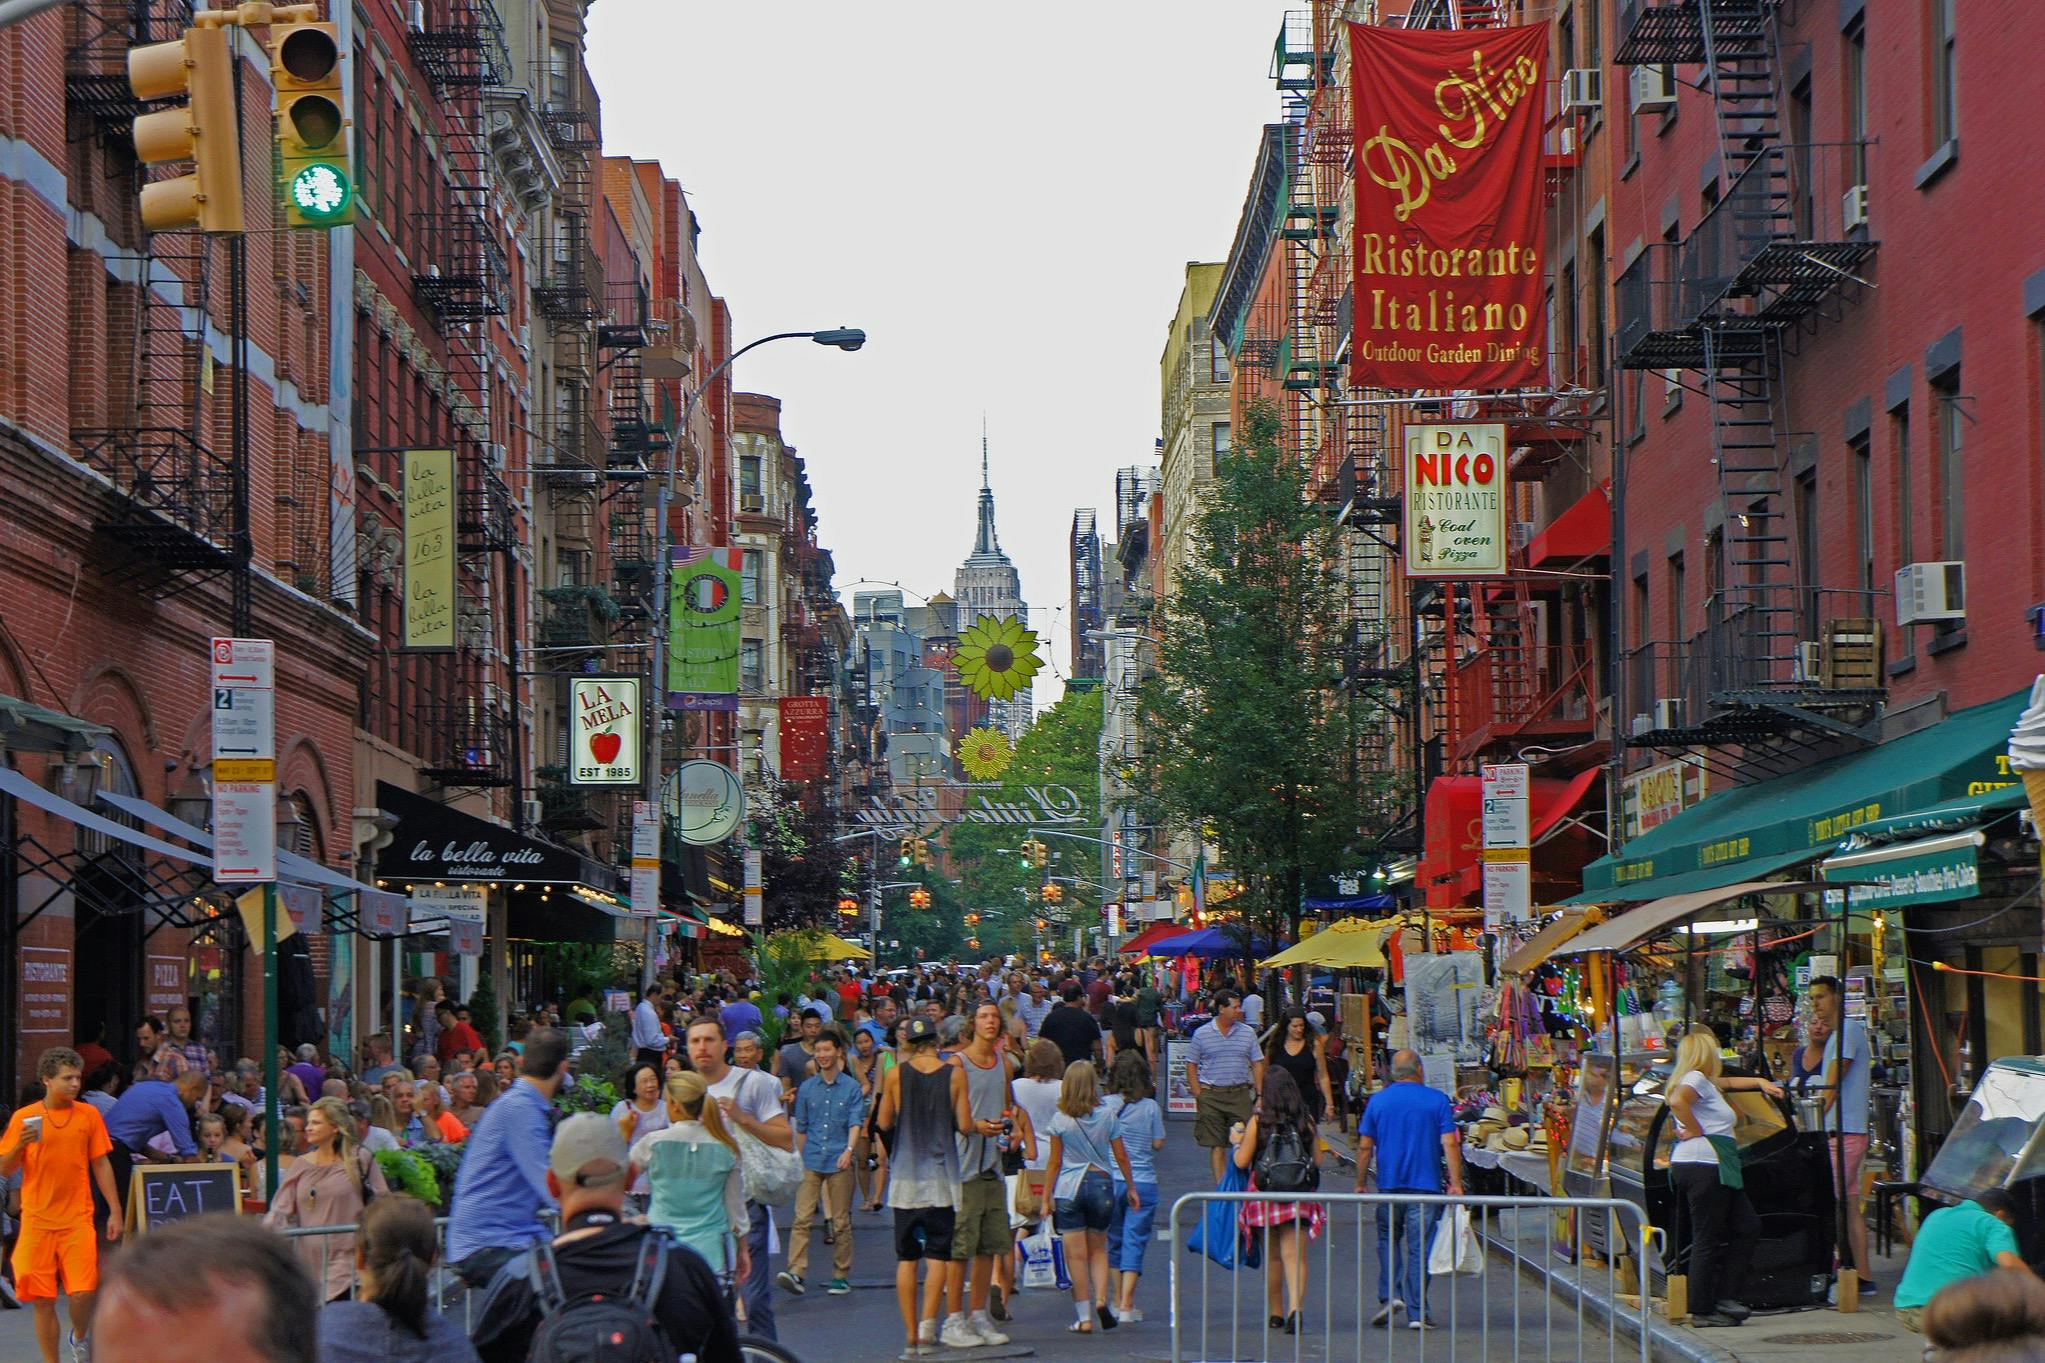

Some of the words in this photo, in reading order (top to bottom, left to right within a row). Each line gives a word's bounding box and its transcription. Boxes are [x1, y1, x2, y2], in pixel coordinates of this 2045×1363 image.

[1362, 125, 1456, 222] Da
[1435, 50, 1538, 149] Nico
[1362, 233, 1537, 277] Ristorante
[1371, 289, 1527, 332] Italiano
[1362, 340, 1423, 363] Outdoor
[1426, 342, 1482, 364] Garden
[1437, 431, 1473, 447] DA
[411, 461, 437, 481] la
[1415, 453, 1494, 486] NICO
[407, 479, 448, 504] bella
[1413, 492, 1497, 510] RISTORANTE
[410, 500, 447, 519] vita
[1438, 518, 1476, 532] Coal
[413, 534, 443, 560] 163
[1453, 535, 1491, 546] oven
[1438, 548, 1479, 562] Pizza
[413, 580, 437, 601] la
[409, 599, 449, 624] bella
[410, 619, 448, 639] vita
[217, 690, 229, 708] 2
[578, 685, 613, 711] LA
[580, 701, 632, 731] MELA
[580, 768, 601, 777] EST
[606, 767, 631, 777] 1985
[1484, 768, 1495, 780] NO
[230, 785, 261, 793] PARKING
[1486, 801, 1493, 813] 2
[410, 840, 435, 862] la
[441, 841, 497, 863] bella
[502, 848, 544, 864] vita
[447, 864, 506, 876] ristorante
[154, 965, 179, 987] PIZZA
[146, 1180, 213, 1214] EAT
